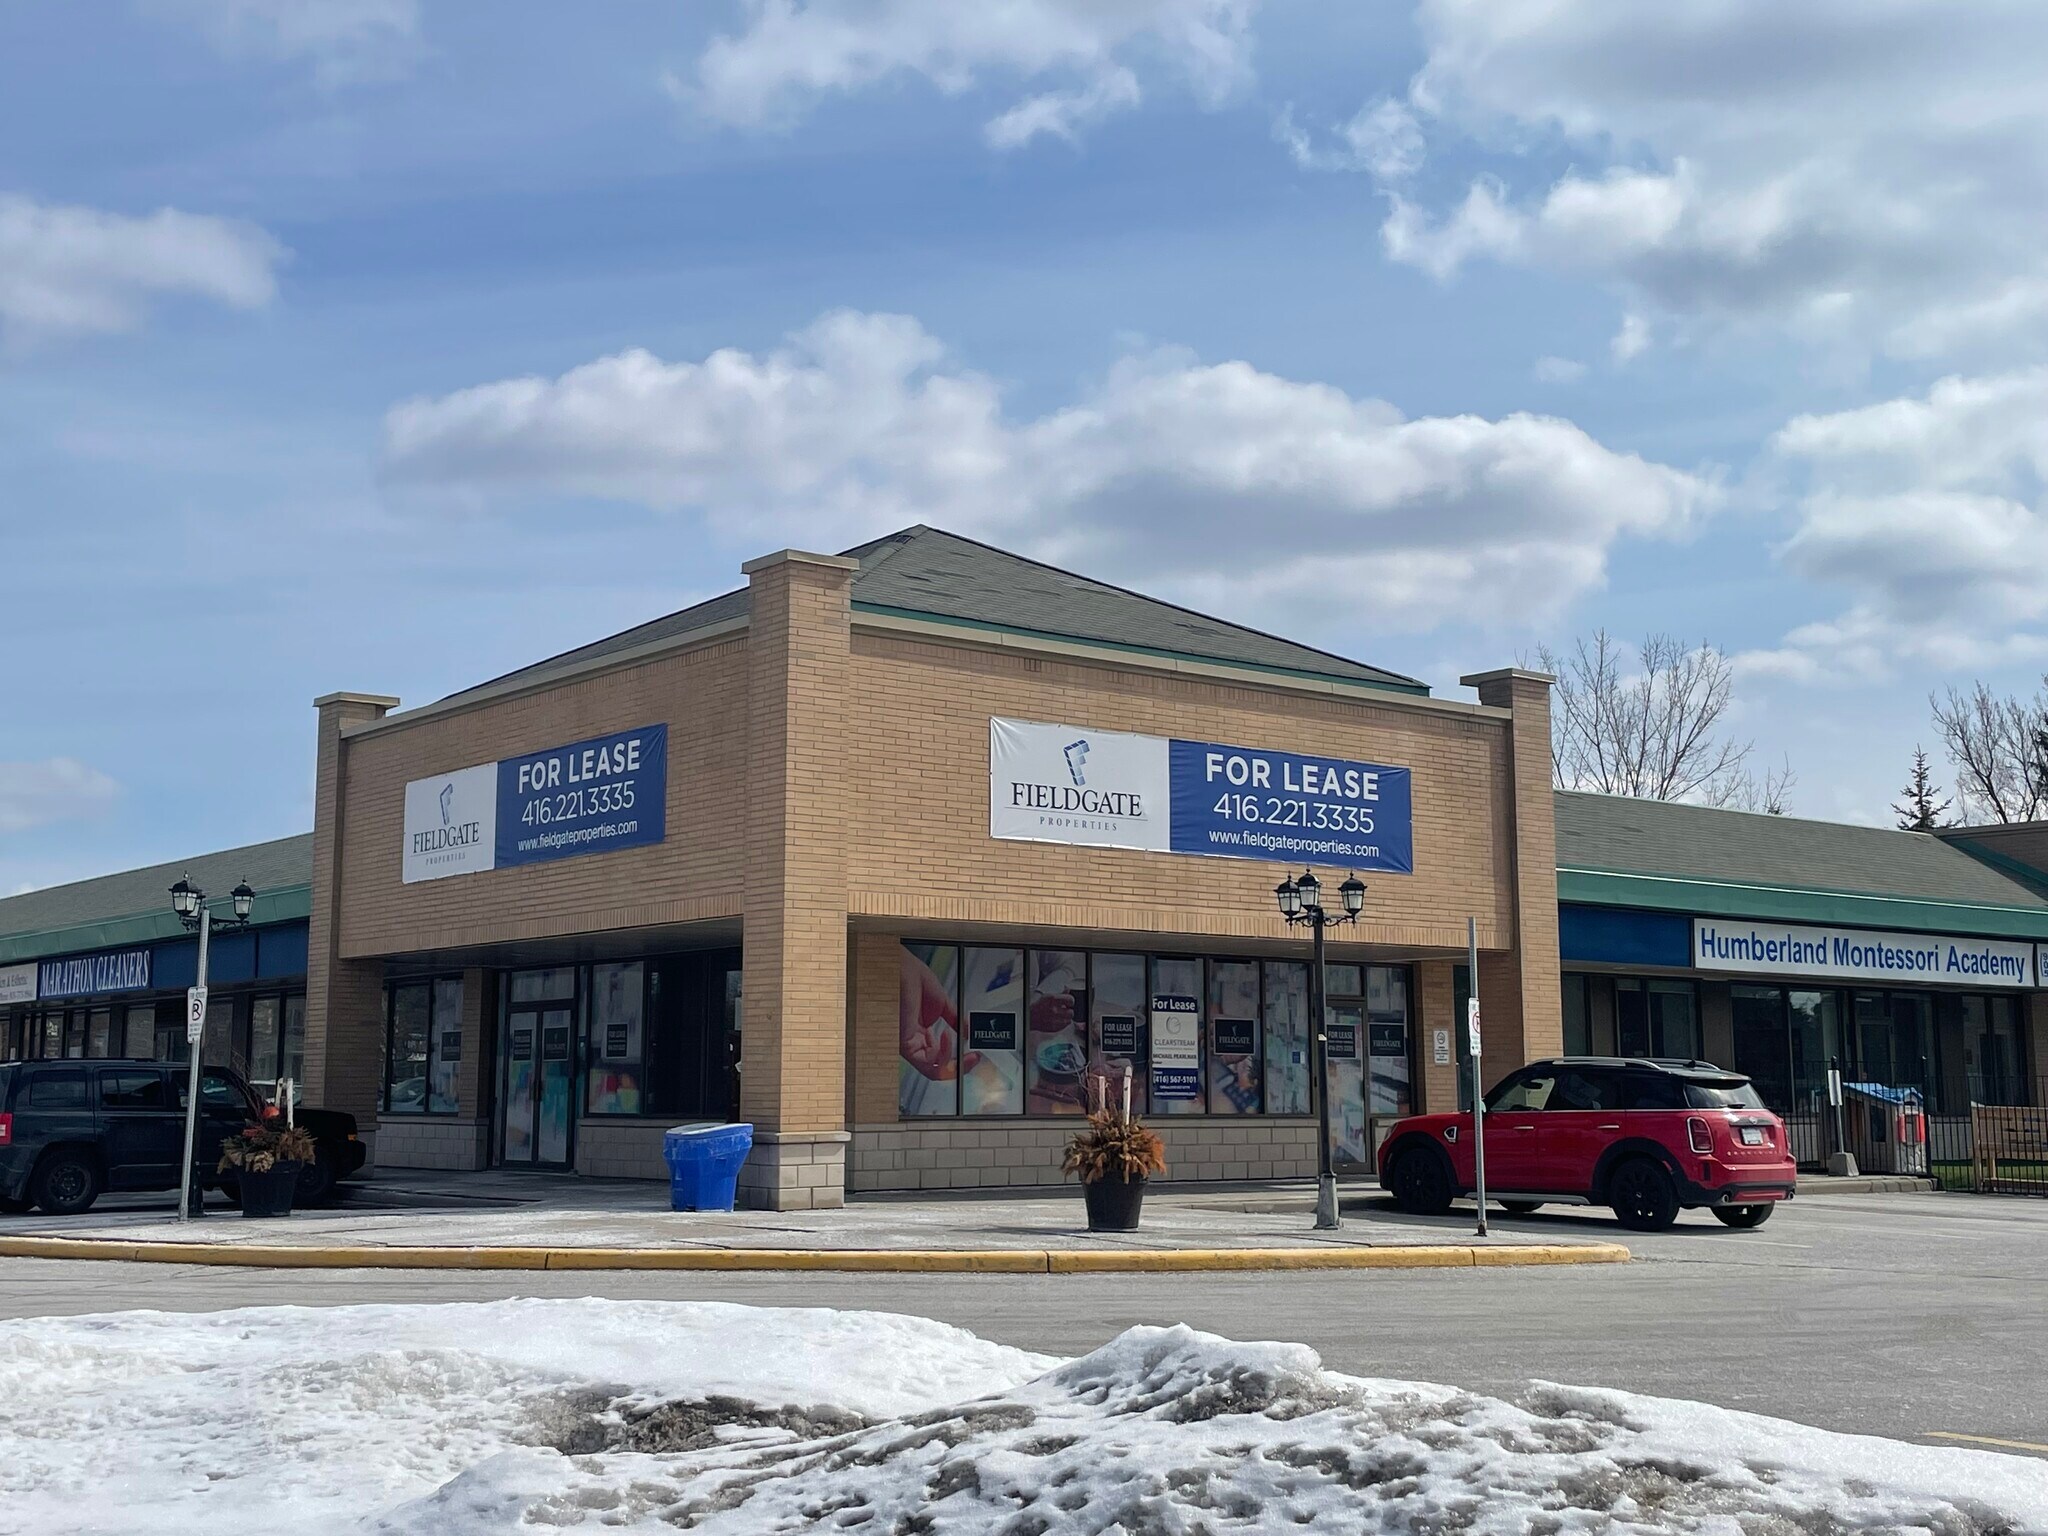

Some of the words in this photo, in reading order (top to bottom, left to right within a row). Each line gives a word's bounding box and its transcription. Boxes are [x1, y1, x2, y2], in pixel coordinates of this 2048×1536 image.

[518, 758, 560, 794] FOR
[568, 739, 641, 785] LEASE
[1206, 753, 1271, 789] FOR
[1284, 762, 1380, 801] LEASE
[521, 780, 635, 827] 416.221.3335
[1011, 781, 1145, 818] FIELDGATE
[1213, 792, 1374, 834] 416.221.3335
[413, 821, 480, 854] FIELDGATE
[517, 819, 638, 852] www.fieldgateproperties.com
[1039, 816, 1118, 831] PROPERTIES
[425, 852, 466, 866] PROPERTIES
[1209, 828, 1380, 858] www.fieldgateproperties.com
[1700, 927, 1828, 966] Humberland
[1833, 937, 1939, 972] Montessori
[1945, 945, 2025, 984] Academy
[40, 957, 95, 997] MARATHON
[96, 950, 150, 991] CLEANERS
[1152, 998, 1168, 1009] For
[1170, 998, 1196, 1010] Lease
[974, 1030, 1011, 1040] FIELDGATE
[1104, 1023, 1115, 1031] FOR
[1116, 1023, 1132, 1031] LEASE
[1219, 1036, 1250, 1045] FIELDGATE
